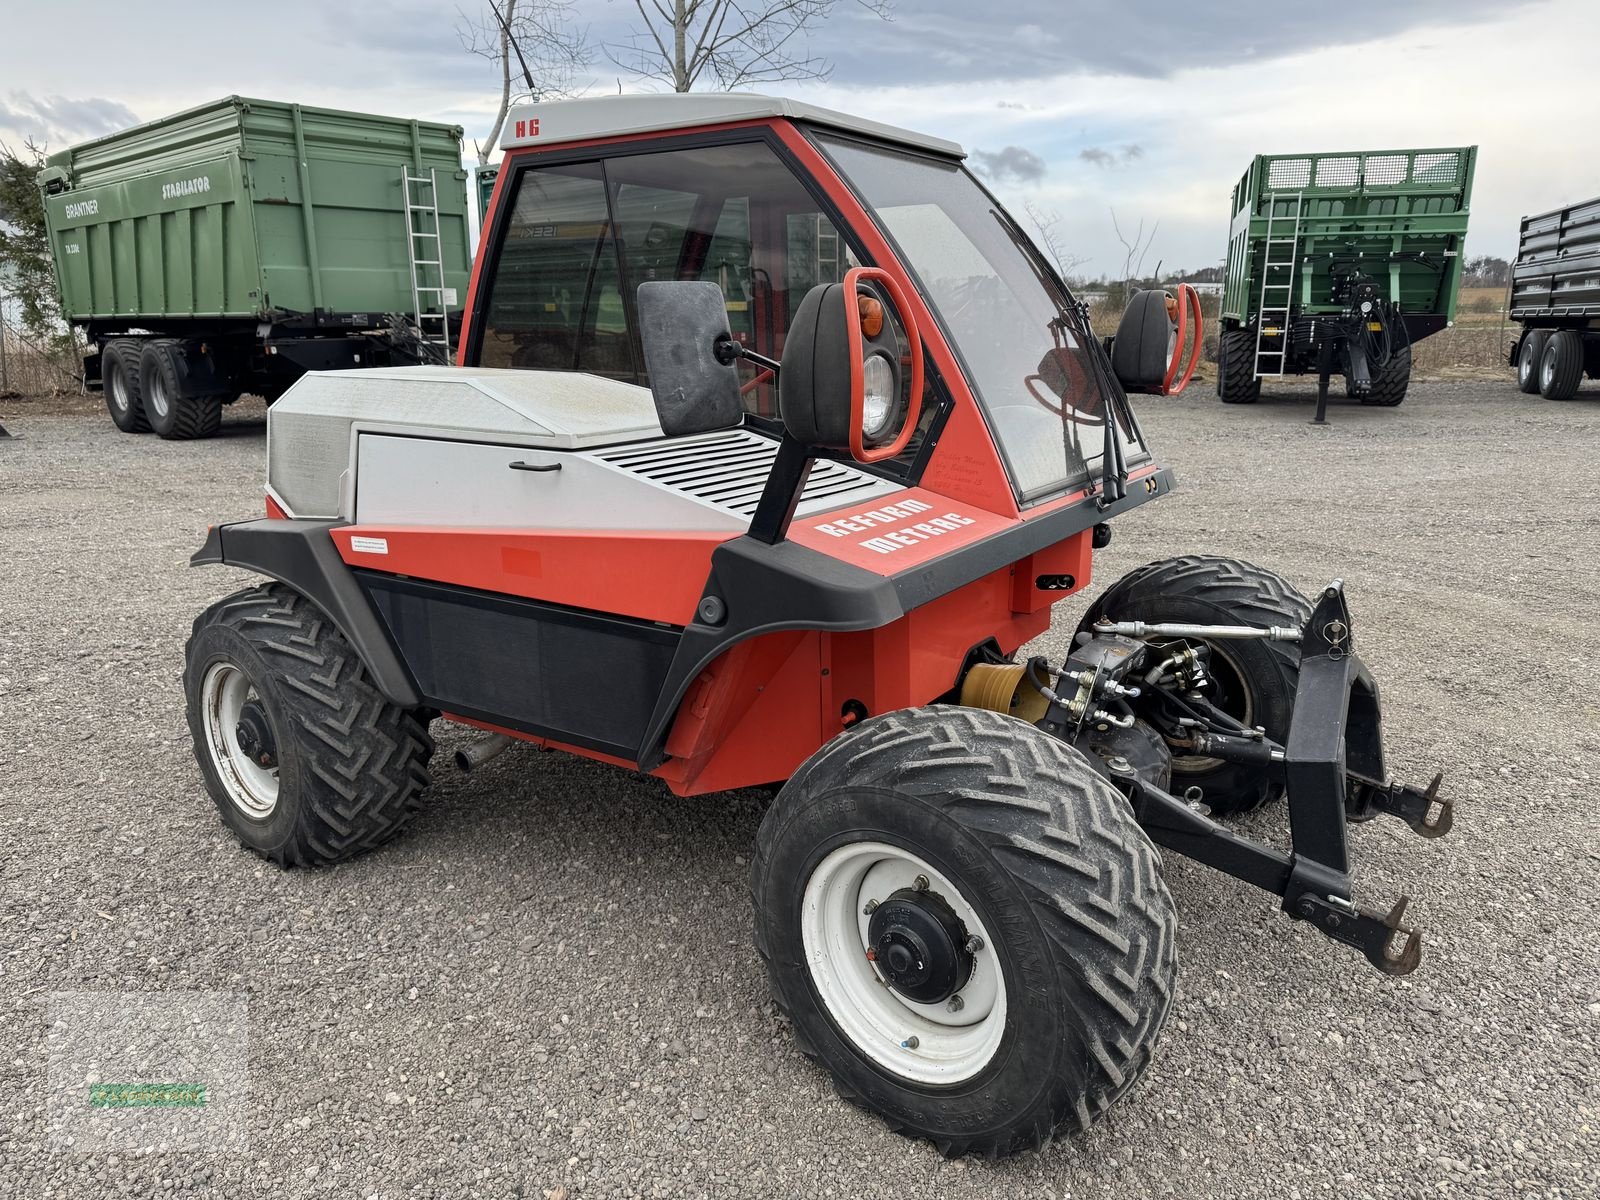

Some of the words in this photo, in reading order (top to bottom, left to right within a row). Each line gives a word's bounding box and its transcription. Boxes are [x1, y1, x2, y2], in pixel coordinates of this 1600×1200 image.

[516, 121, 525, 138] H
[529, 119, 539, 136] 6
[162, 176, 210, 199] STABILATOR
[65, 200, 98, 218] BRANTNER
[813, 499, 933, 538] REFORM
[858, 512, 977, 554] METRAC
